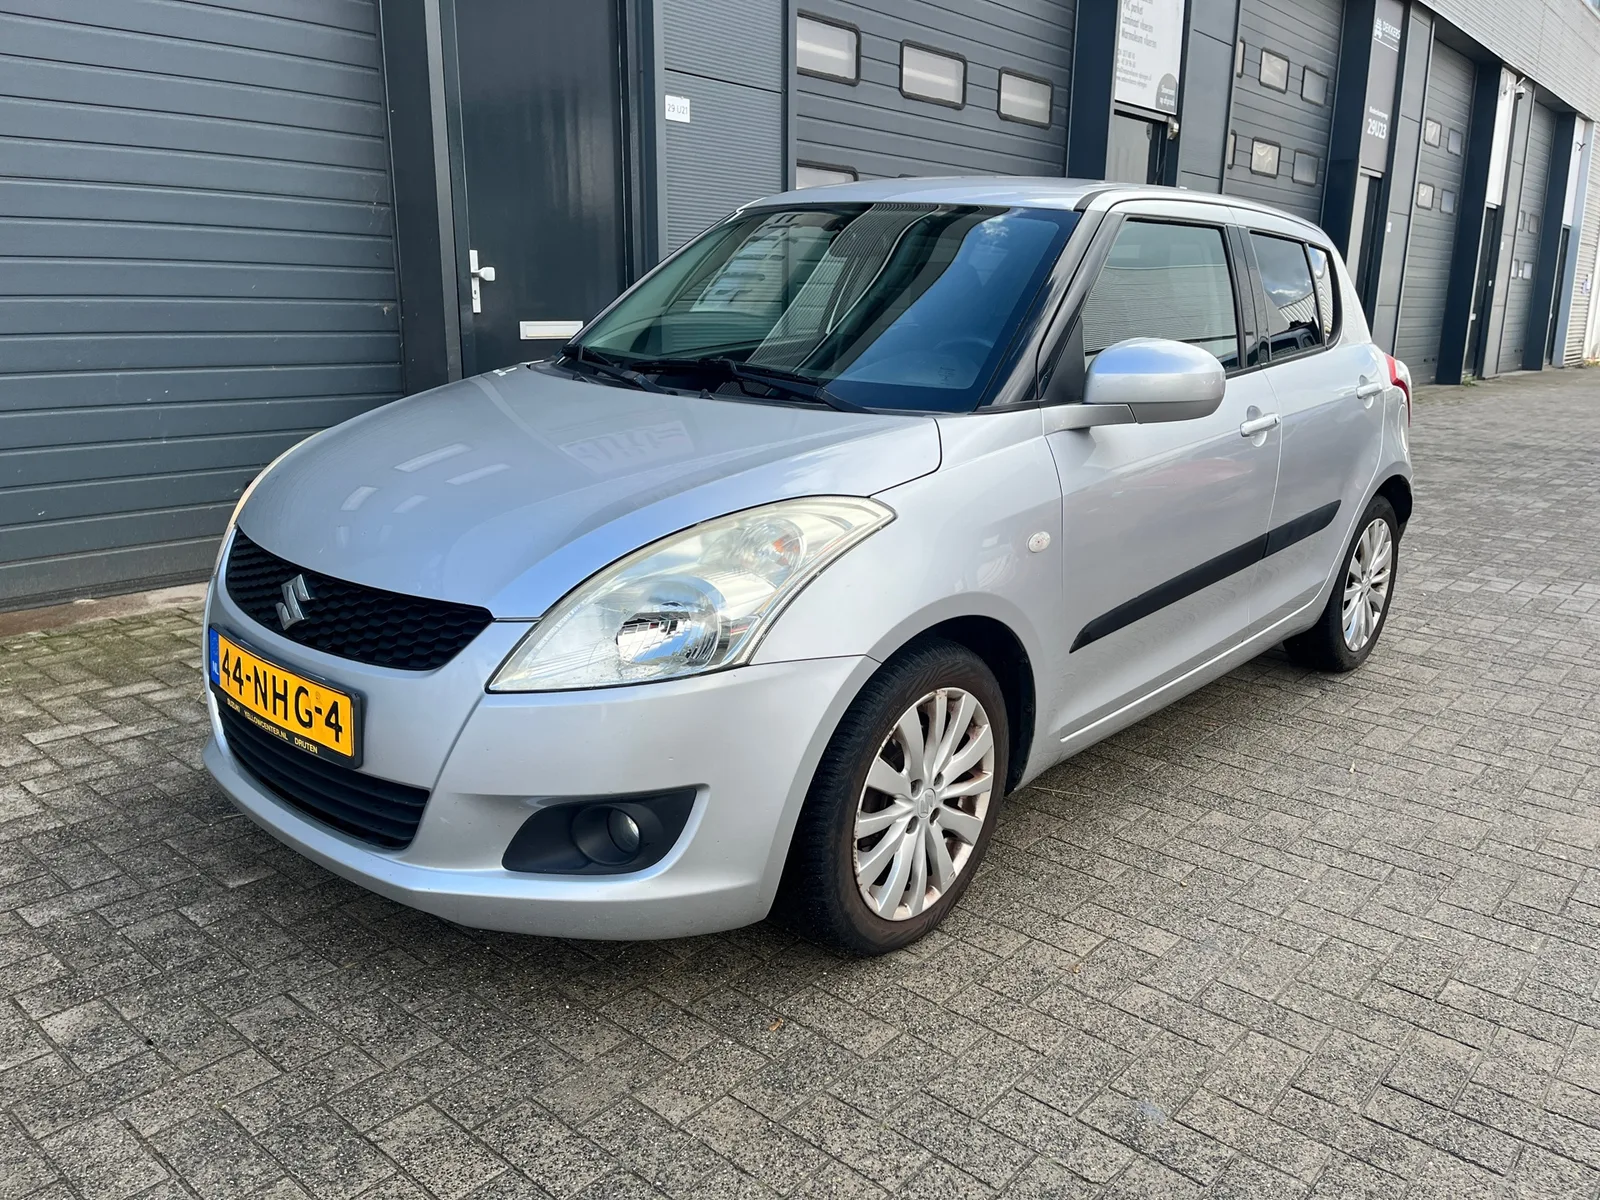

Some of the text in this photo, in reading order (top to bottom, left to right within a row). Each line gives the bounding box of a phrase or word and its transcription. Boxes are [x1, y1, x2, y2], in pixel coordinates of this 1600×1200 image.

[667, 103, 688, 115] 29 U21
[1367, 118, 1387, 139] 29U23
[212, 660, 219, 676] NL
[221, 647, 343, 743] 44-NHG-4
[244, 710, 289, 741] YELLOWCENTER.NL
[294, 736, 318, 755] DRUTEN
